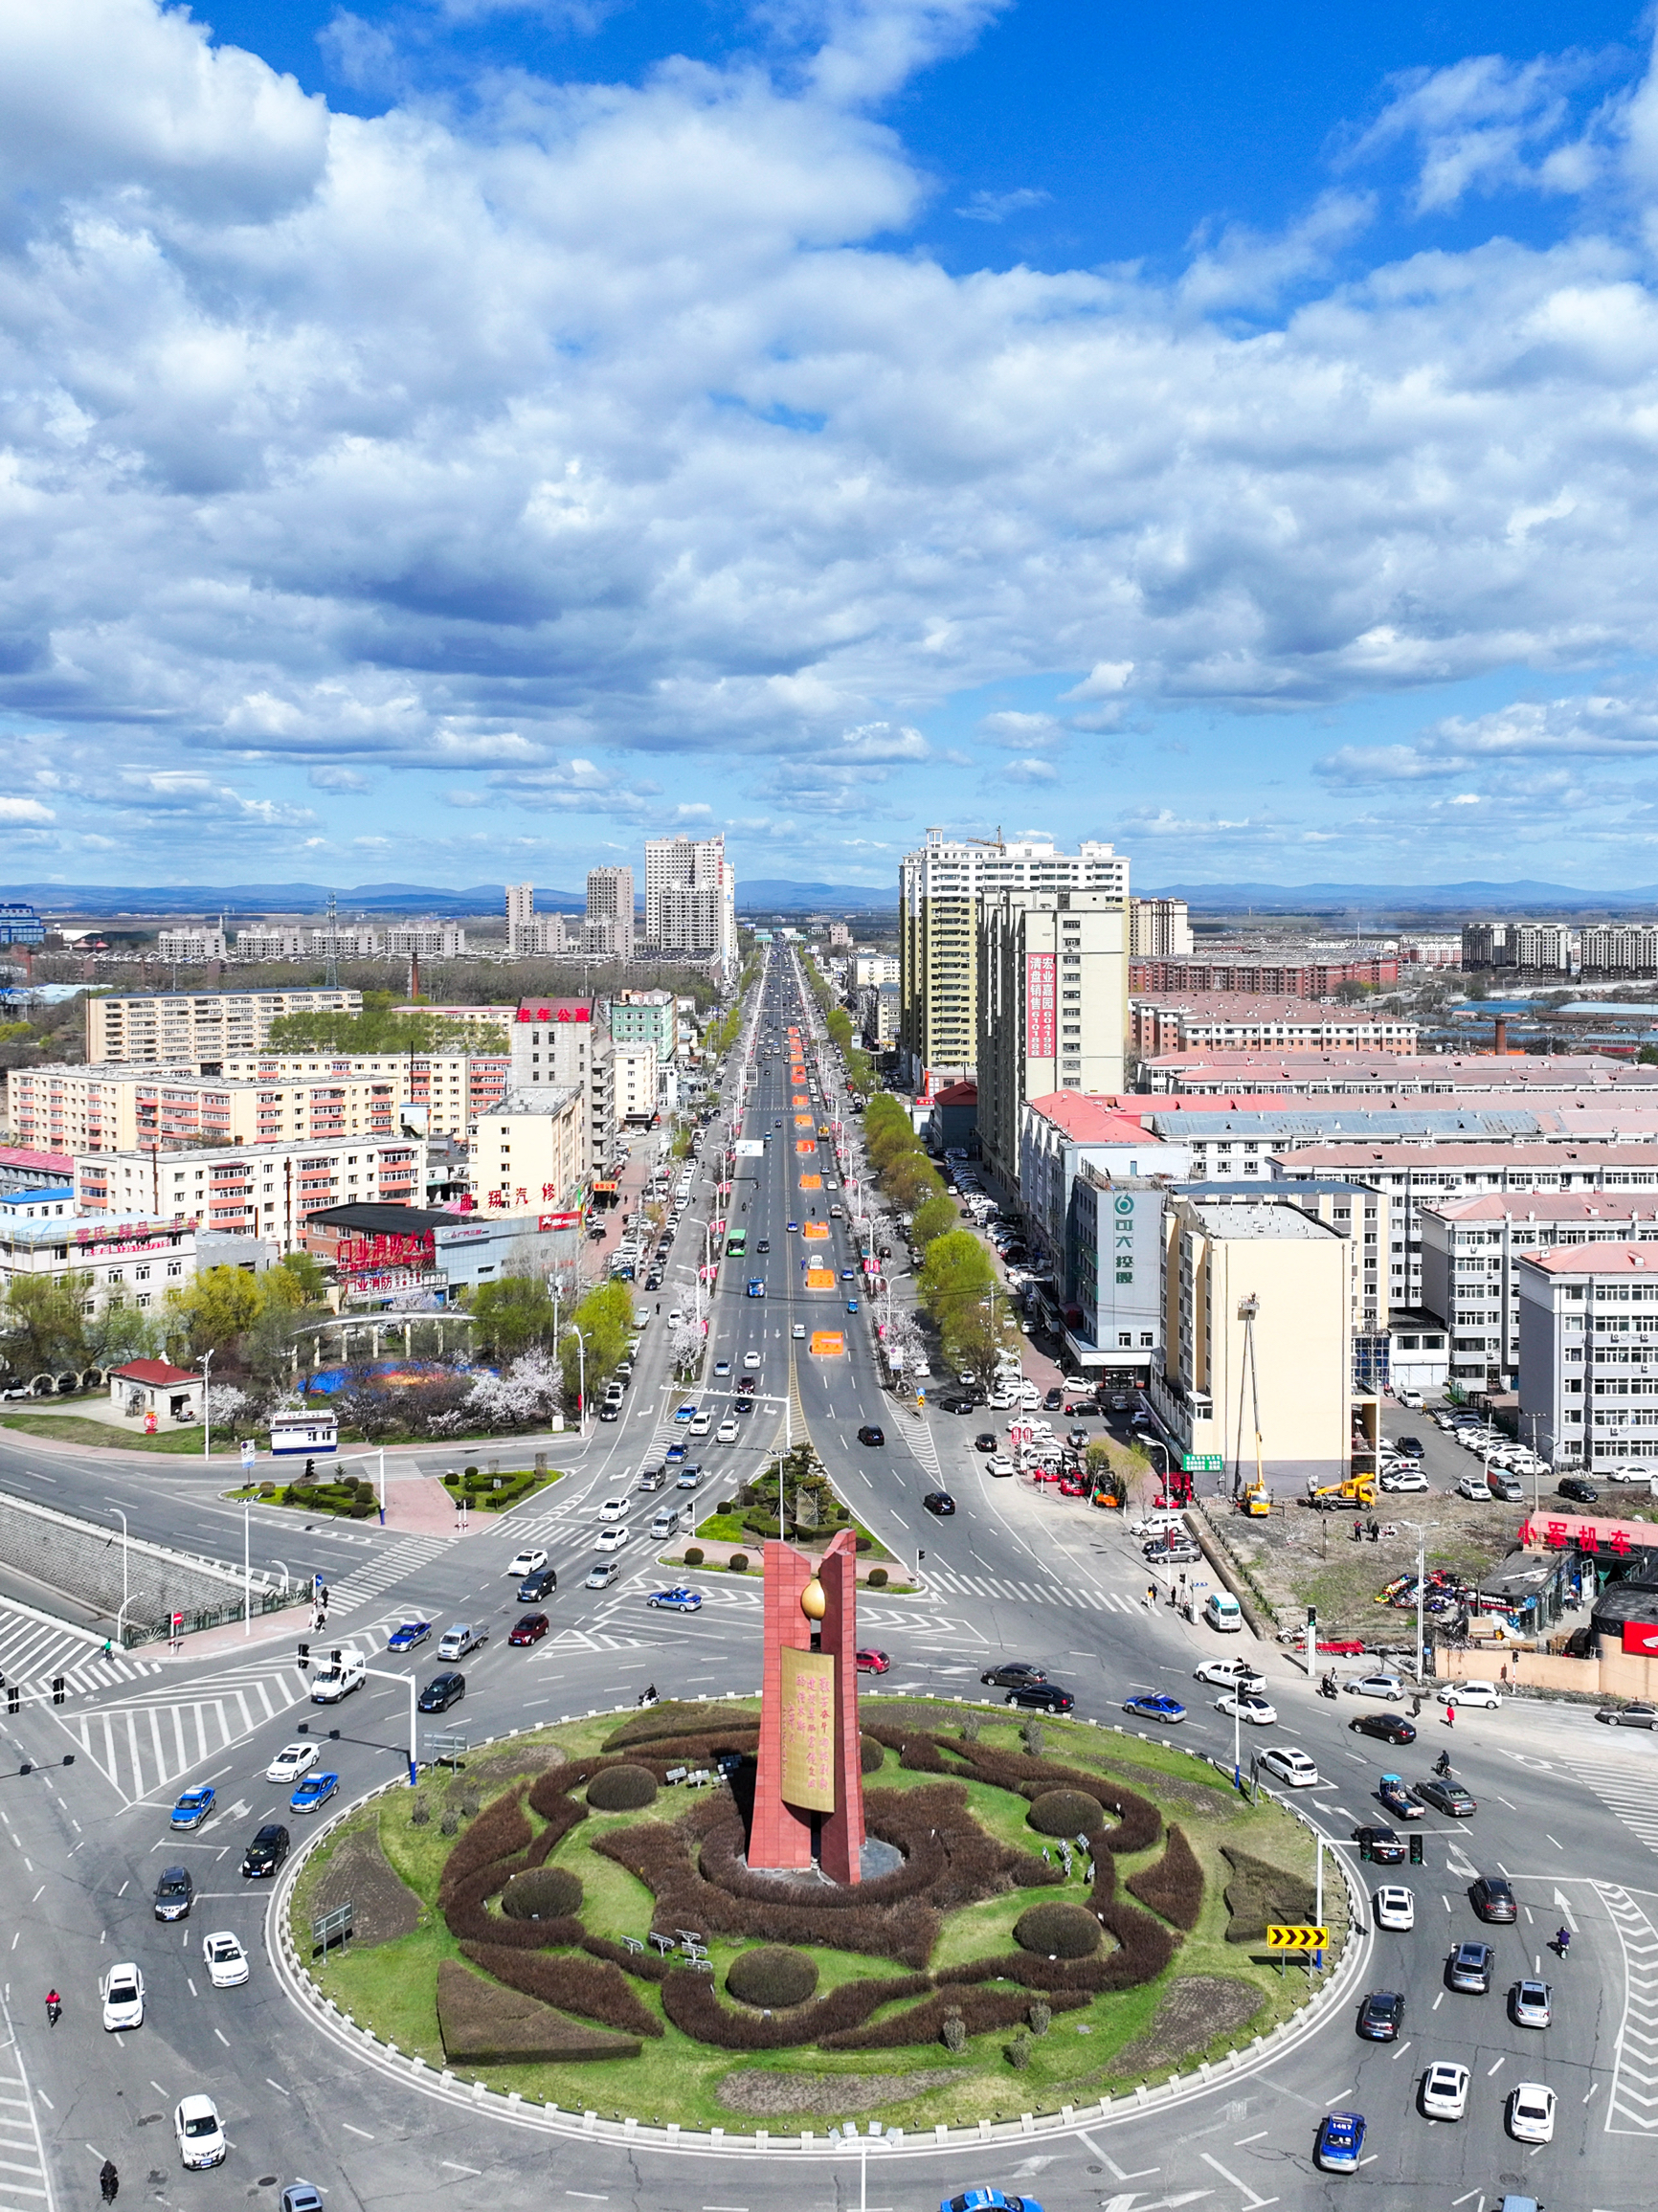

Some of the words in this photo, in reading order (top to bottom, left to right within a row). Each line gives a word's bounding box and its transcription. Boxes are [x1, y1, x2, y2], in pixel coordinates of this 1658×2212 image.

[629, 995, 664, 1005] 幼儿园
[517, 1008, 590, 1023] 老年公寓
[460, 1182, 555, 1212] 鹰翔汽修
[1517, 1519, 1632, 1556] 小军机车
